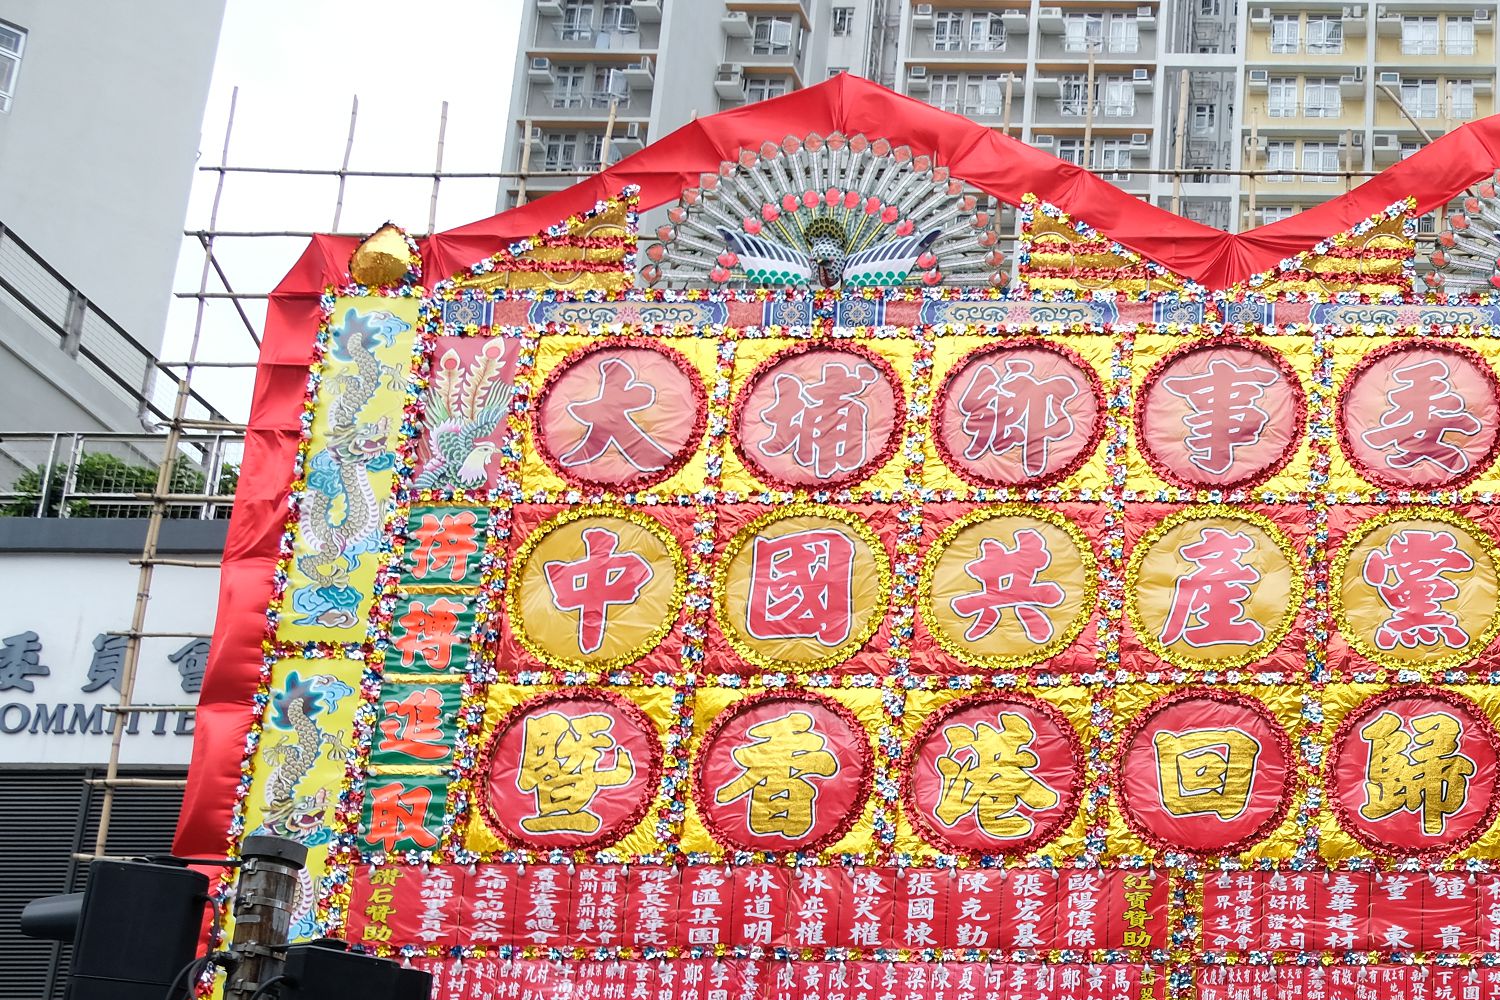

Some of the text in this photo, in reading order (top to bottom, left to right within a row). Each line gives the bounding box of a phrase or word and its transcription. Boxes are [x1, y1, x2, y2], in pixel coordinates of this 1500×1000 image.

[365, 511, 478, 851] 拼搏進取
[743, 869, 780, 944] 林道明
[848, 871, 888, 946] 陳笑權
[903, 873, 939, 947] 張國棟
[955, 873, 993, 948] 陳克勤
[1012, 873, 1046, 948] 張宏基
[1067, 873, 1099, 948] 歐陽偉傑
[1122, 874, 1154, 948] 紅寶贊助
[1288, 875, 1310, 949] 有限公司
[1324, 876, 1360, 949] 嘉華建材
